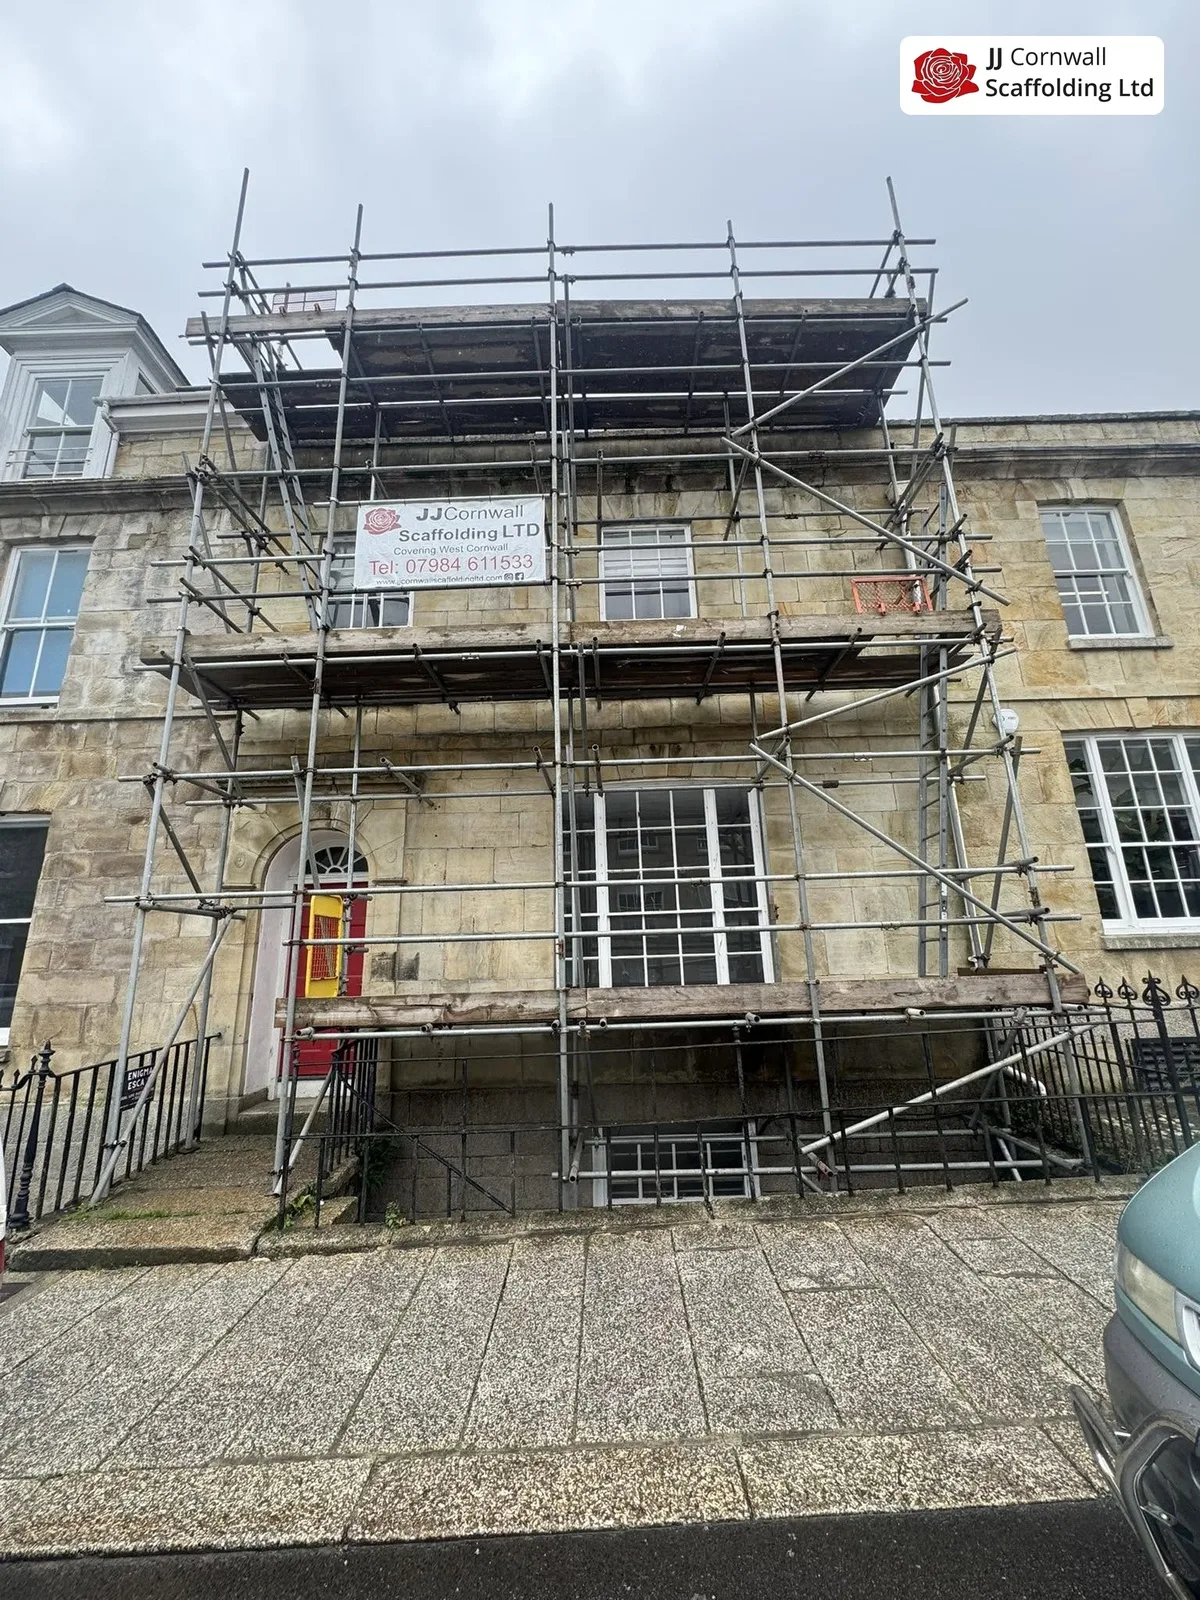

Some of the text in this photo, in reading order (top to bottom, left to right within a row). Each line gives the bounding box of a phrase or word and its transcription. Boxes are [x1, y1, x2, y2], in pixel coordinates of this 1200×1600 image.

[399, 523, 540, 542] Scaffolding LTD
[394, 543, 509, 556] Covering West Cornwall
[369, 554, 533, 575] Tel: 07984 611533
[127, 1078, 145, 1091] ESCA
